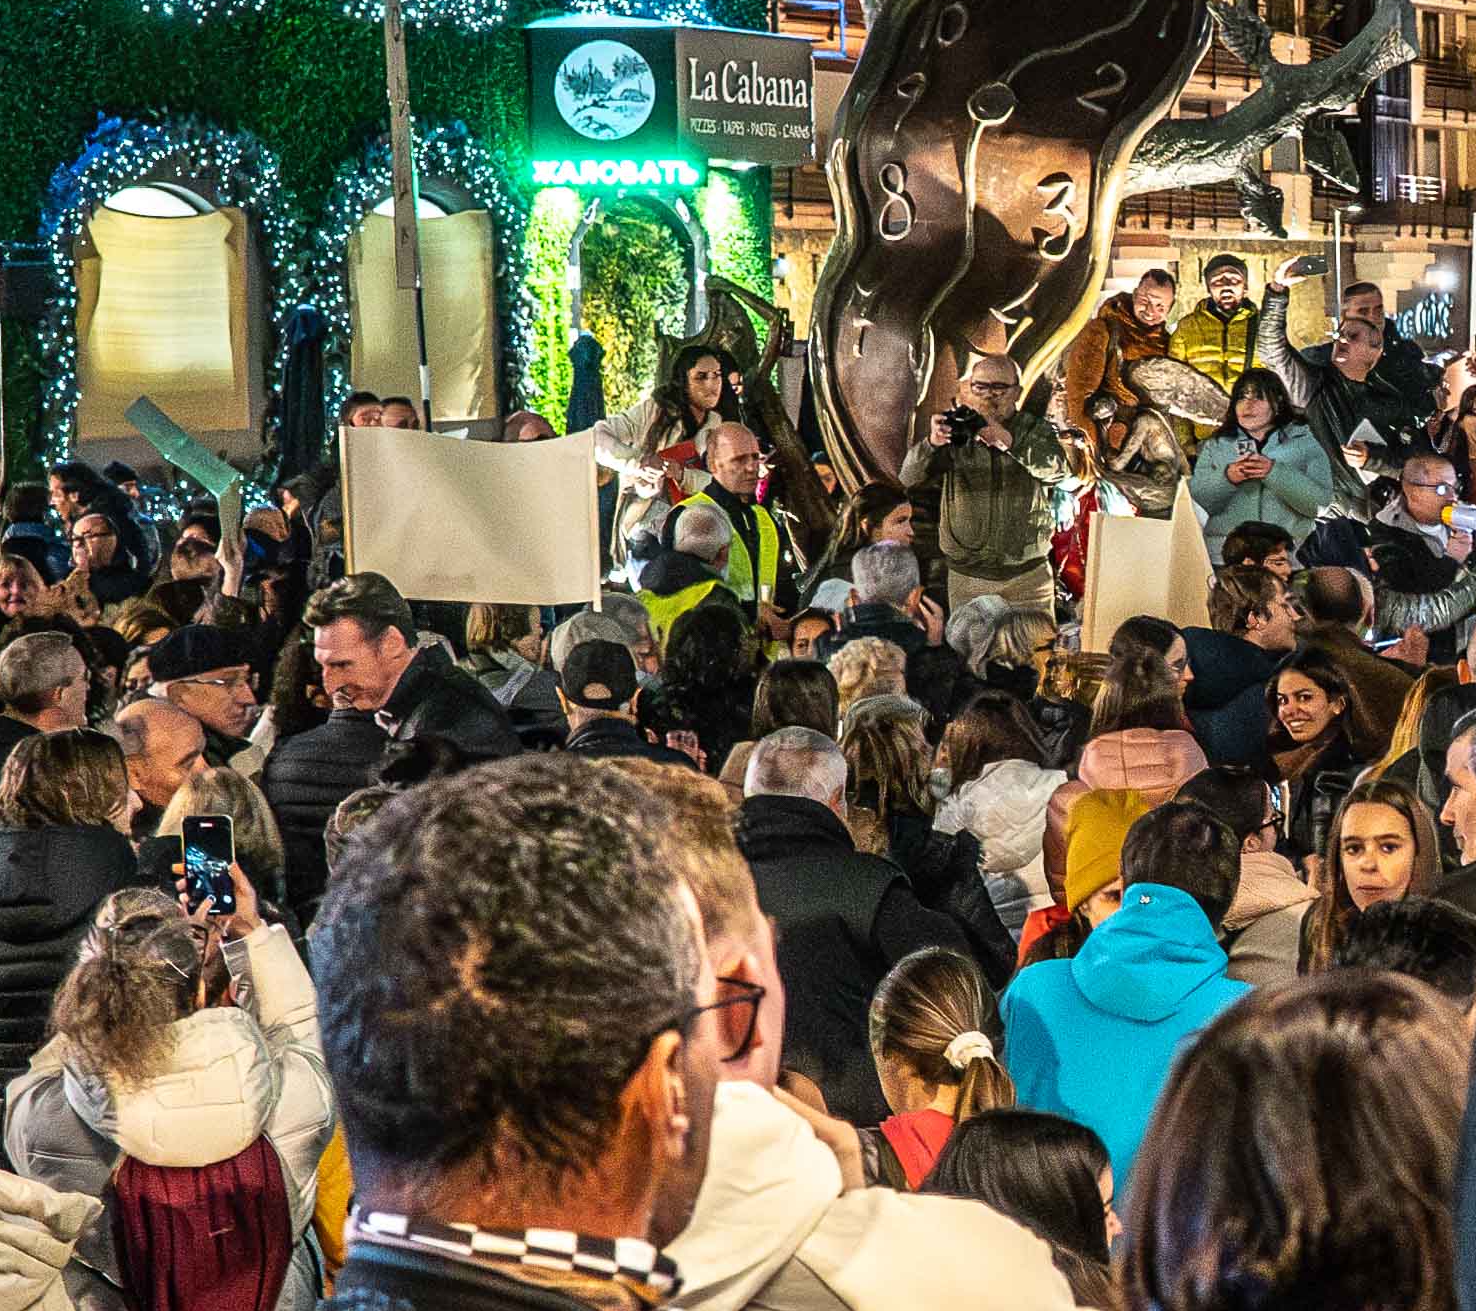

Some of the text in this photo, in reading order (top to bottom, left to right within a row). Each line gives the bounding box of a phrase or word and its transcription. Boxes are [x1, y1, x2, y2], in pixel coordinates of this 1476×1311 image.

[688, 57, 809, 108] La Cabana
[878, 163, 913, 241] 8
[1036, 174, 1079, 261] 3
